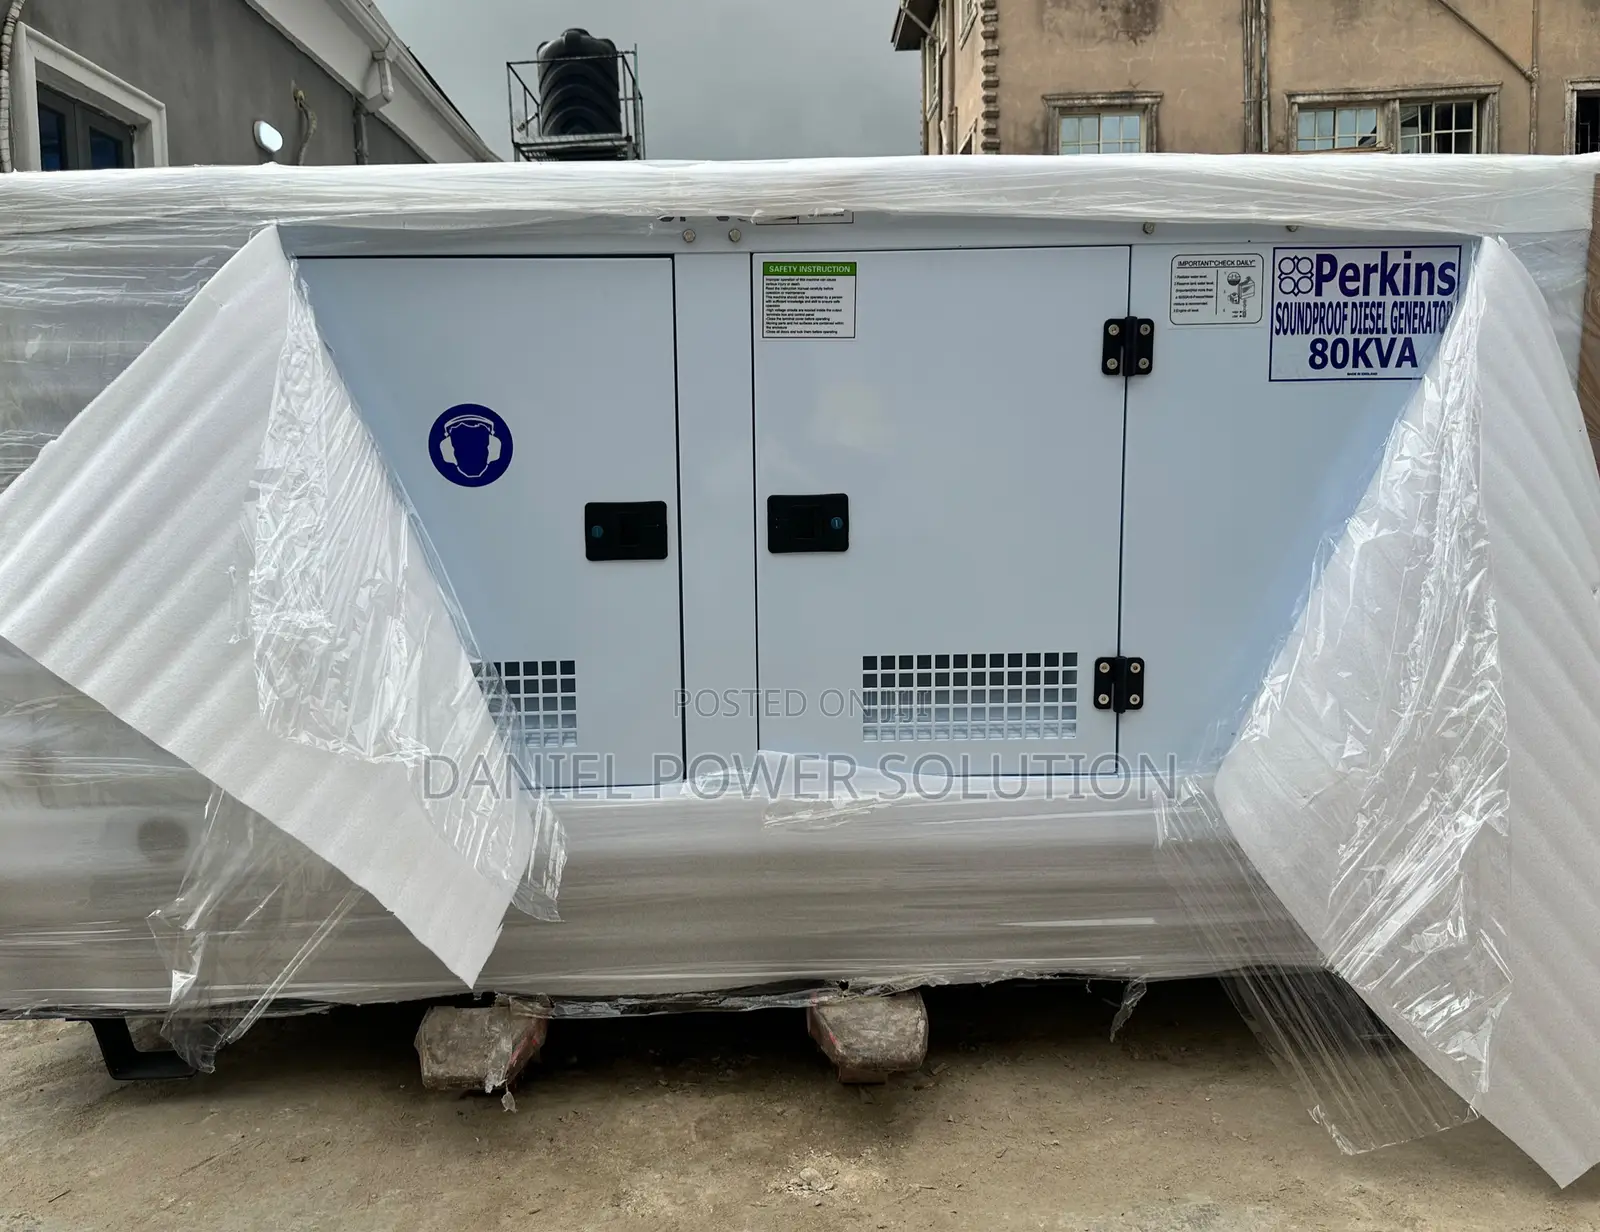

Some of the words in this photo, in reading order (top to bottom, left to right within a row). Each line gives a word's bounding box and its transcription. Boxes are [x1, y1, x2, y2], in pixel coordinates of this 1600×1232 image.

[769, 265, 798, 273] SAFETY
[799, 265, 851, 273] INSTRUCTION
[1314, 251, 1456, 297] Perkins
[1274, 301, 1348, 336] SOUNDPROOF
[1350, 301, 1388, 336] DIESEL
[1308, 337, 1418, 370] 80KVA
